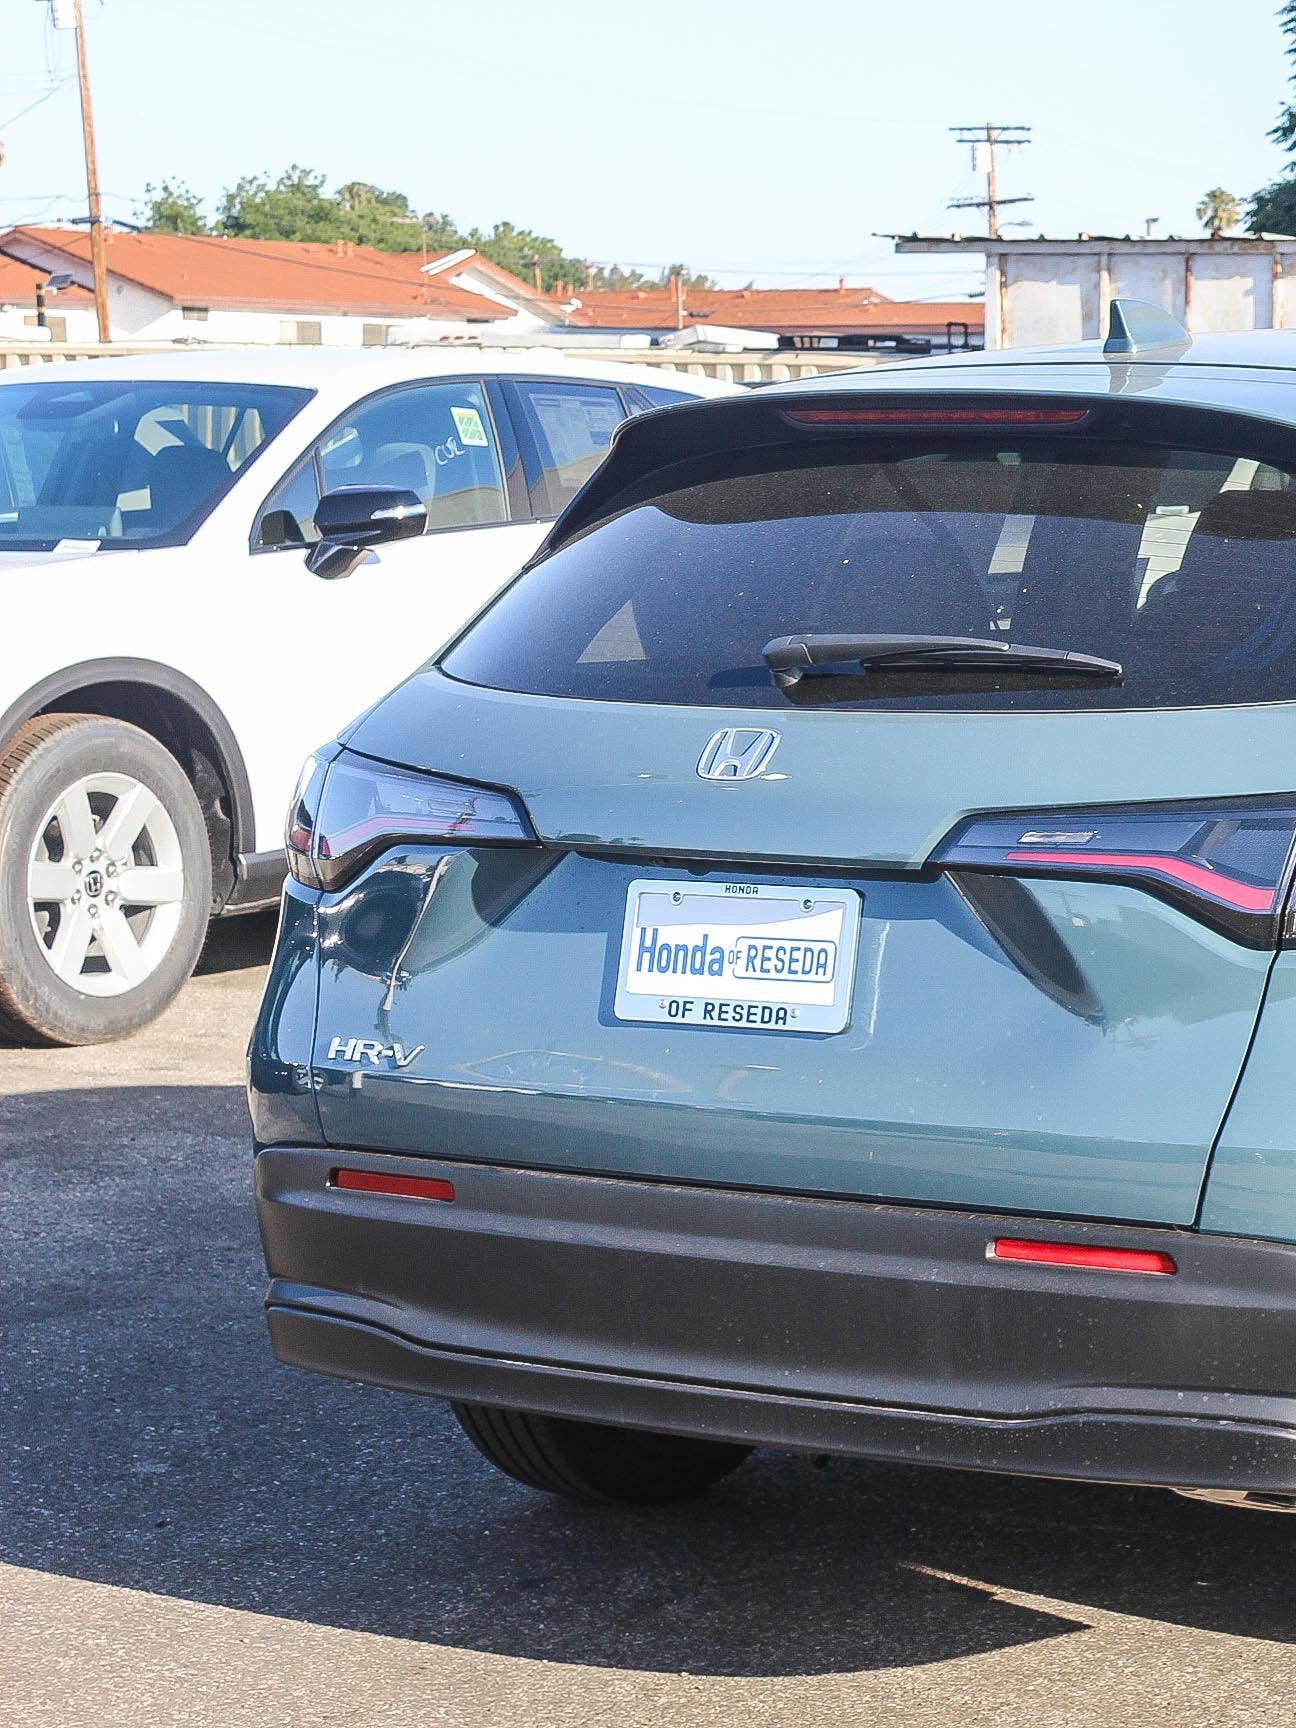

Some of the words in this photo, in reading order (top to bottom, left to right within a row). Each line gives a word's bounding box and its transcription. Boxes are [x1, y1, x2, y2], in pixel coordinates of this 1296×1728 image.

[724, 884, 759, 895] HONDA
[636, 927, 725, 976] Honda
[728, 950, 743, 965] OF
[745, 944, 829, 976] RESEDA
[667, 999, 694, 1019] OF
[703, 1002, 788, 1026] RESEDA
[327, 1035, 426, 1066] HR-V
